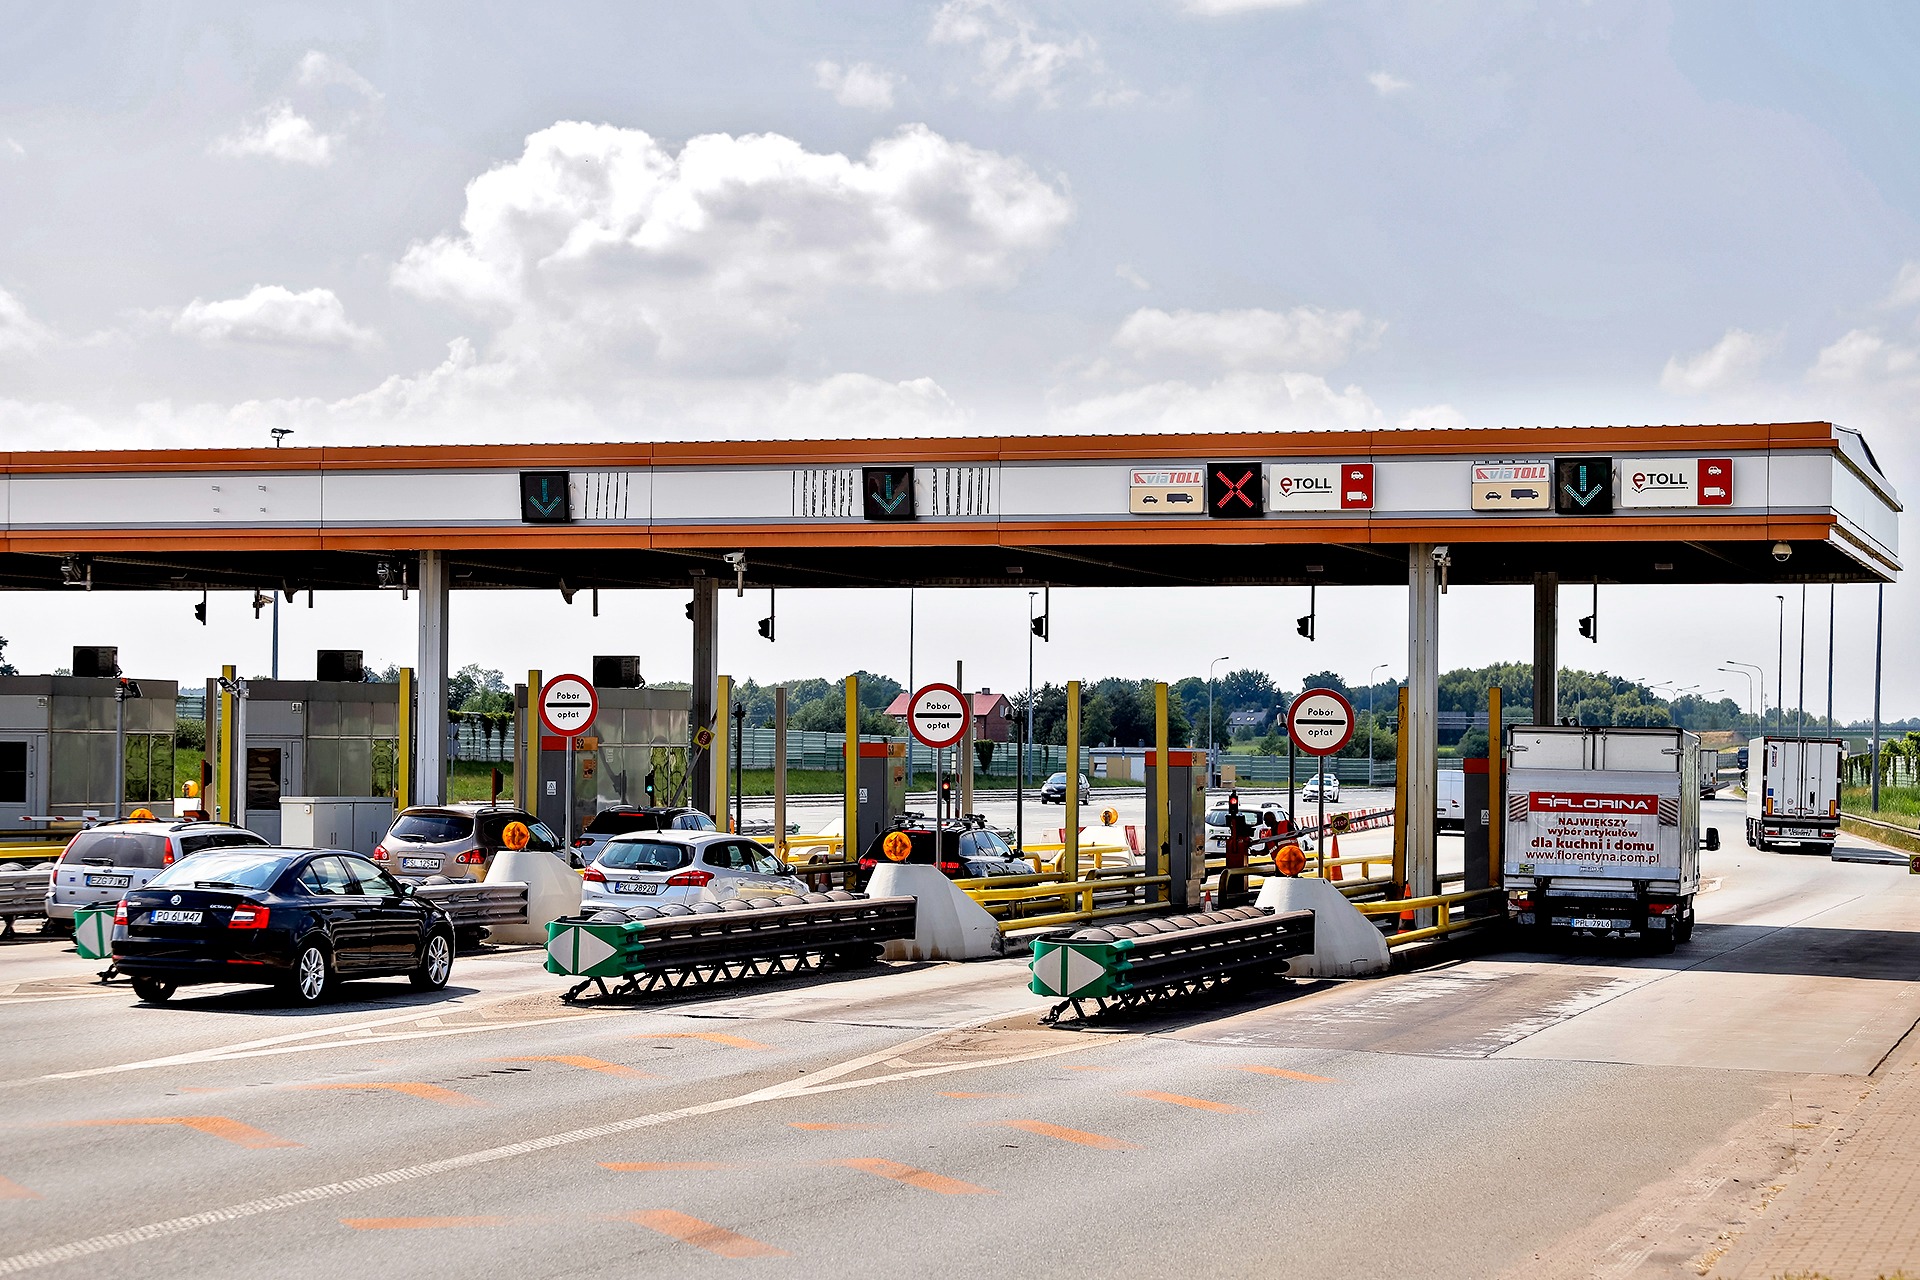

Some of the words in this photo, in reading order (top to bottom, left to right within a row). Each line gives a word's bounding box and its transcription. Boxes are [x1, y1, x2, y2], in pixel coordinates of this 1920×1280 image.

[1145, 472, 1201, 484] viaTOLL
[1489, 466, 1546, 480] viaTOLL
[1280, 477, 1332, 493] eTOLL
[1632, 473, 1688, 489] eTOLL
[557, 691, 580, 700] Pobór
[926, 702, 951, 710] Pobór
[557, 711, 580, 720] opłat
[1307, 707, 1334, 717] Pobór
[926, 721, 950, 731] opłat
[1307, 728, 1333, 738] opłat
[576, 738, 585, 749] 52
[1333, 819, 1348, 828] STOP
[1558, 817, 1629, 829] NAJWIĘKSZY
[1547, 827, 1582, 837] wybór
[1584, 829, 1639, 839] artykułów
[1531, 836, 1553, 848] dla
[1556, 838, 1603, 850] kuchni
[1606, 839, 1611, 850] i
[1614, 840, 1655, 852] domu
[1526, 850, 1661, 865] www.florentyna.com.pl
[171, 912, 201, 922] 6LM47
